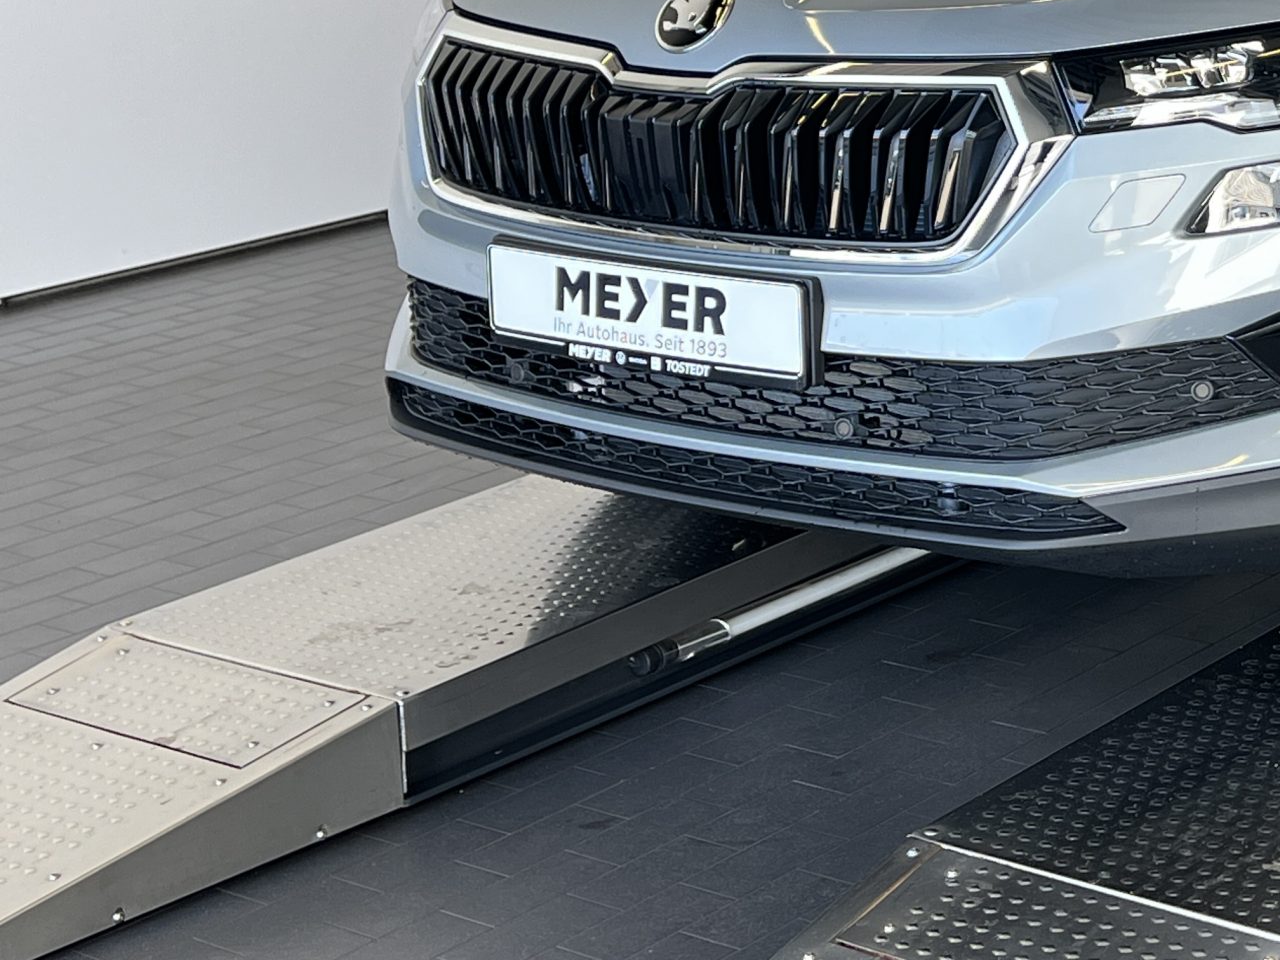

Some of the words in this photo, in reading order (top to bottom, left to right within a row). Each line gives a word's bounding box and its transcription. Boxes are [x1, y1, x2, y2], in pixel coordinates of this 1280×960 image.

[555, 266, 726, 336] MEYER
[553, 317, 573, 334] Ihr
[576, 322, 650, 348] Autohaus.
[654, 333, 685, 353] Seit
[689, 338, 728, 359] 1893
[568, 343, 612, 363] MEYER
[665, 359, 711, 377] TOSTEDT
